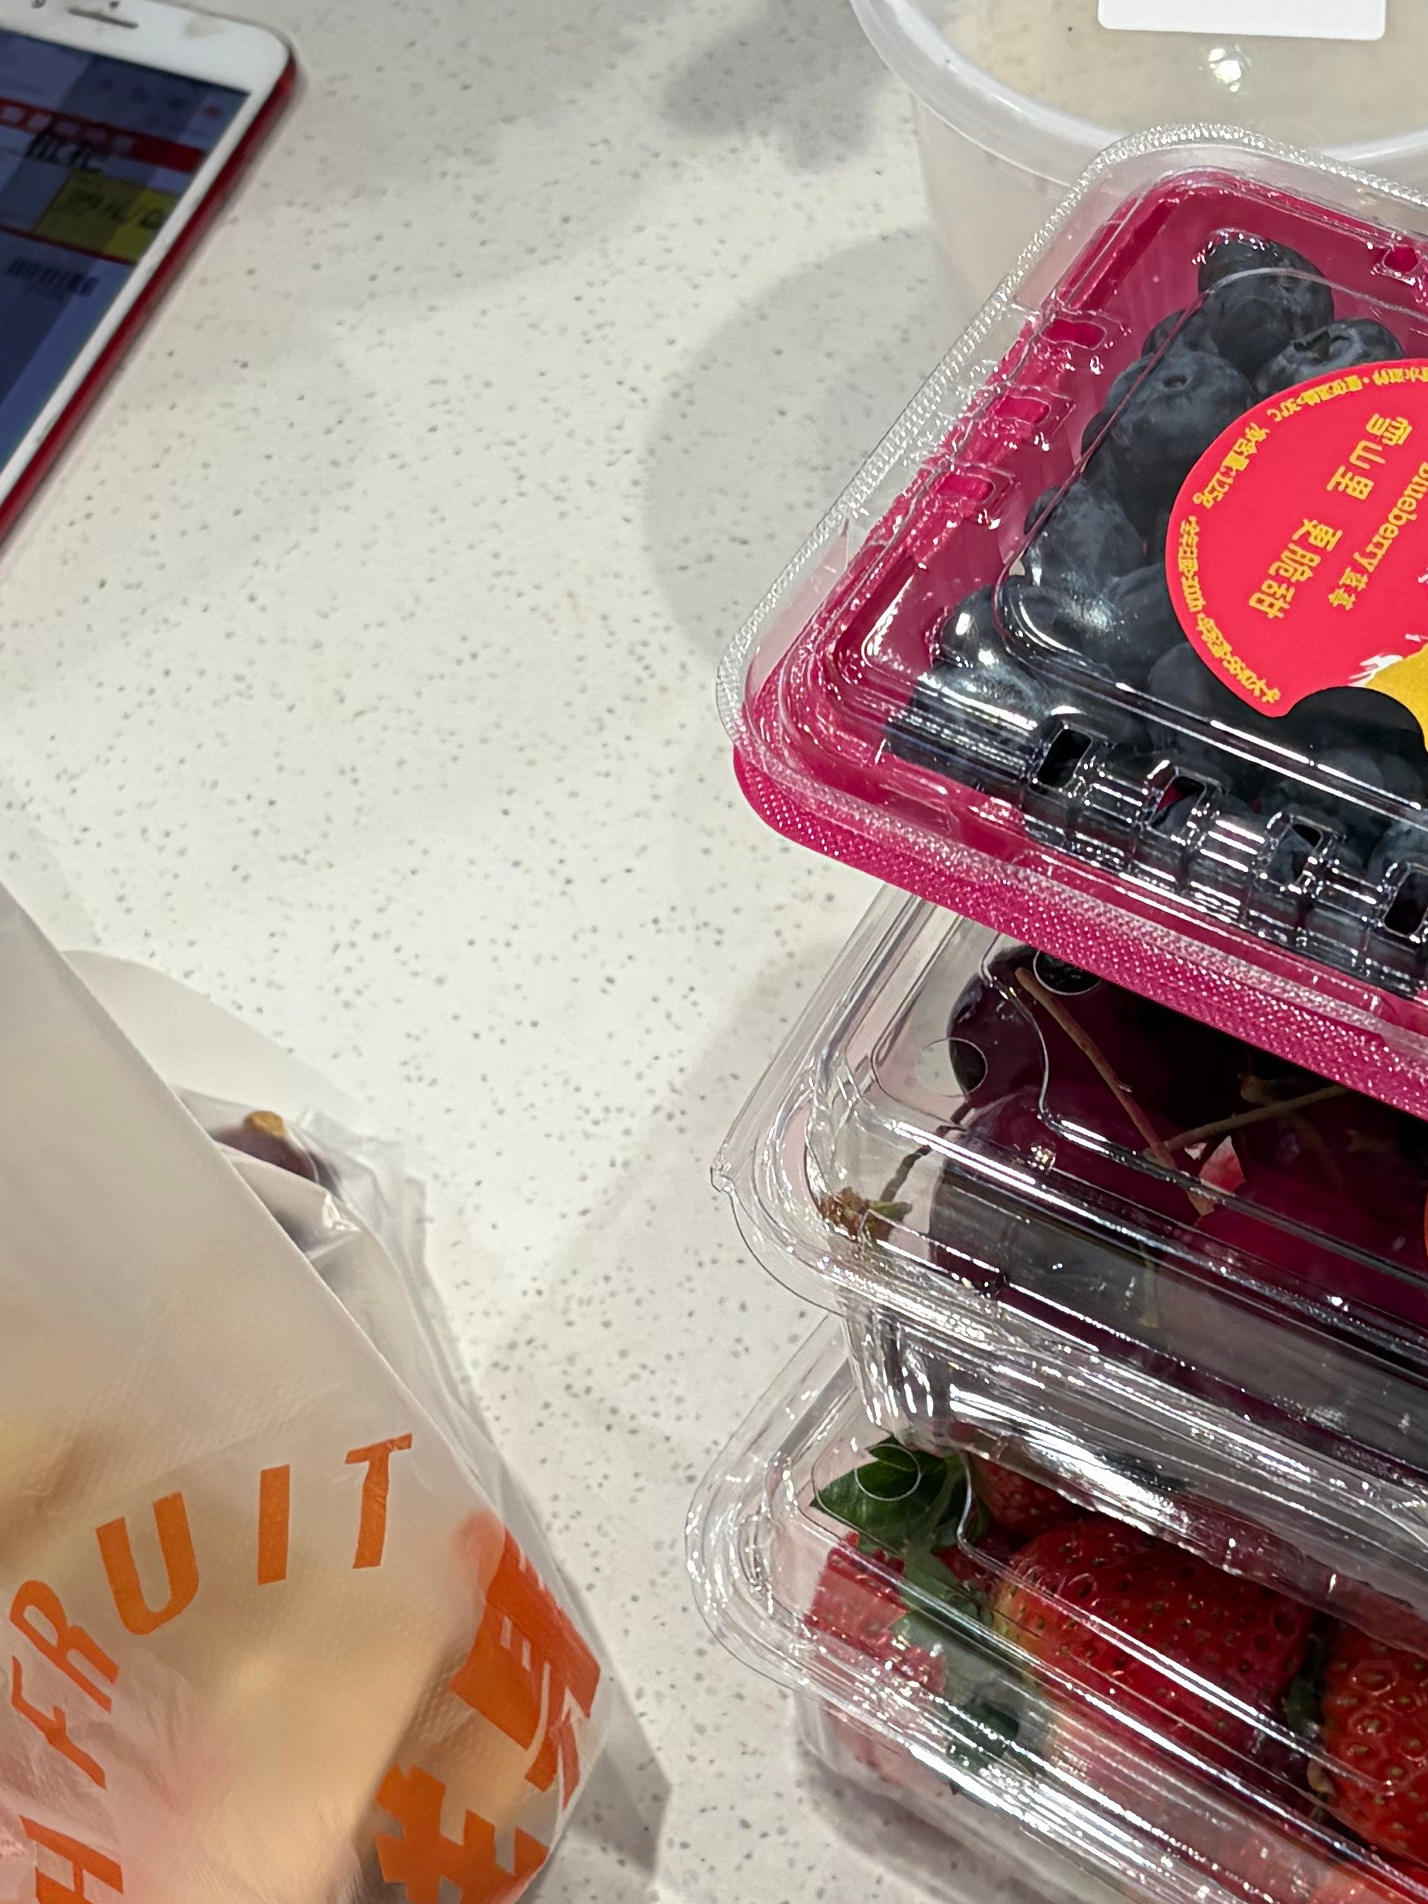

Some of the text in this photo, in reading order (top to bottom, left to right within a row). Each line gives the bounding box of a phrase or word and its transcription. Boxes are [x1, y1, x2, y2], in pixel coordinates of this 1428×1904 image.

[1326, 413, 1413, 500] 雪山里
[1248, 517, 1343, 619] 更脆甜
[8, 1432, 414, 1791] FRUIT
